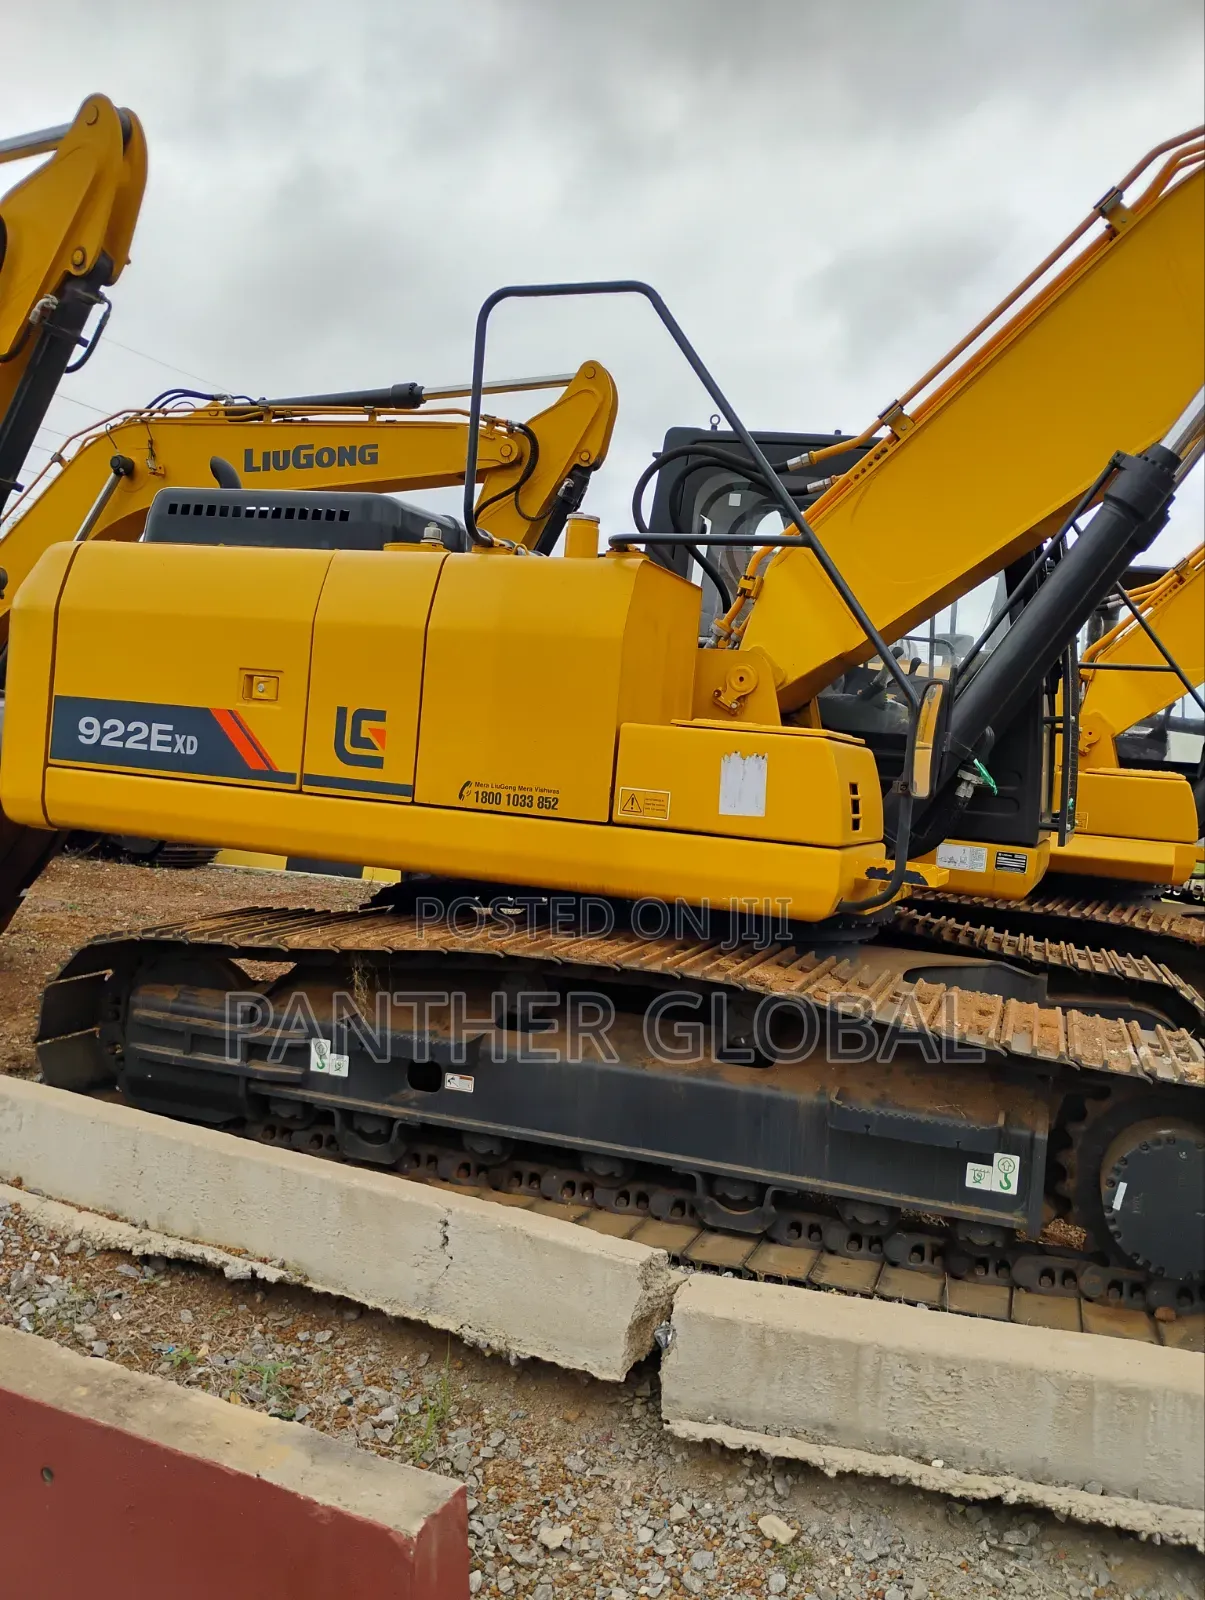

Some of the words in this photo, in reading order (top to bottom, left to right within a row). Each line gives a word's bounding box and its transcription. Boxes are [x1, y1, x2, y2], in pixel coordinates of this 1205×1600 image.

[474, 791, 502, 805] 1800
[506, 793, 534, 808] 1033
[537, 796, 559, 810] 852
